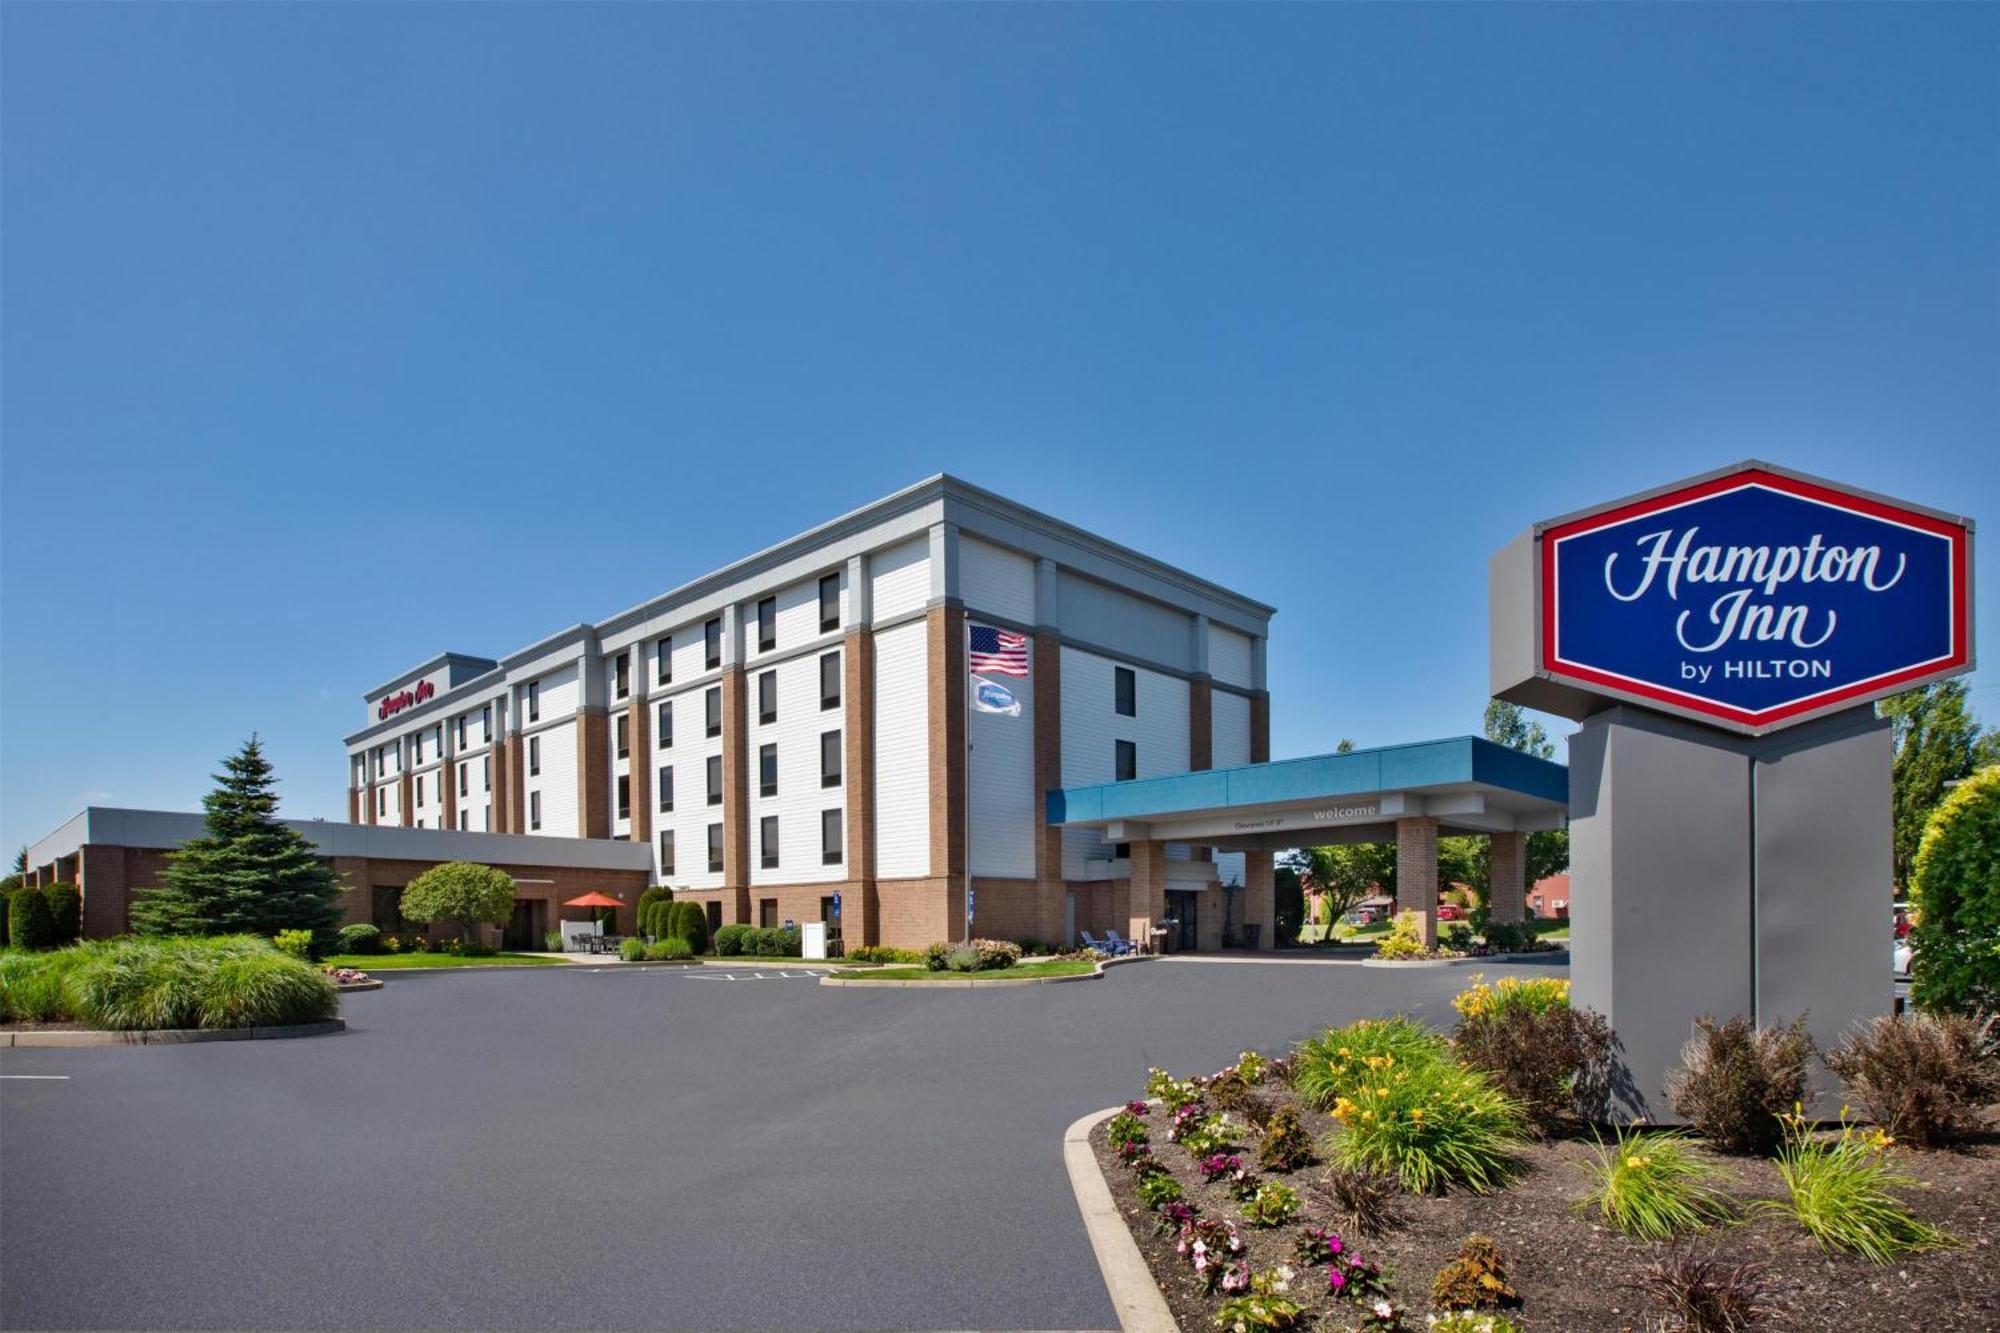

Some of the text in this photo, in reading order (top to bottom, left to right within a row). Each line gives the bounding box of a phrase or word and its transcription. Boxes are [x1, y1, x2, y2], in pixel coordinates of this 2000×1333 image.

[1605, 526, 1906, 602] Hampton
[1676, 588, 1837, 653] Inn
[1681, 659, 1832, 684] by HILTON
[1313, 805, 1376, 820] welcome
